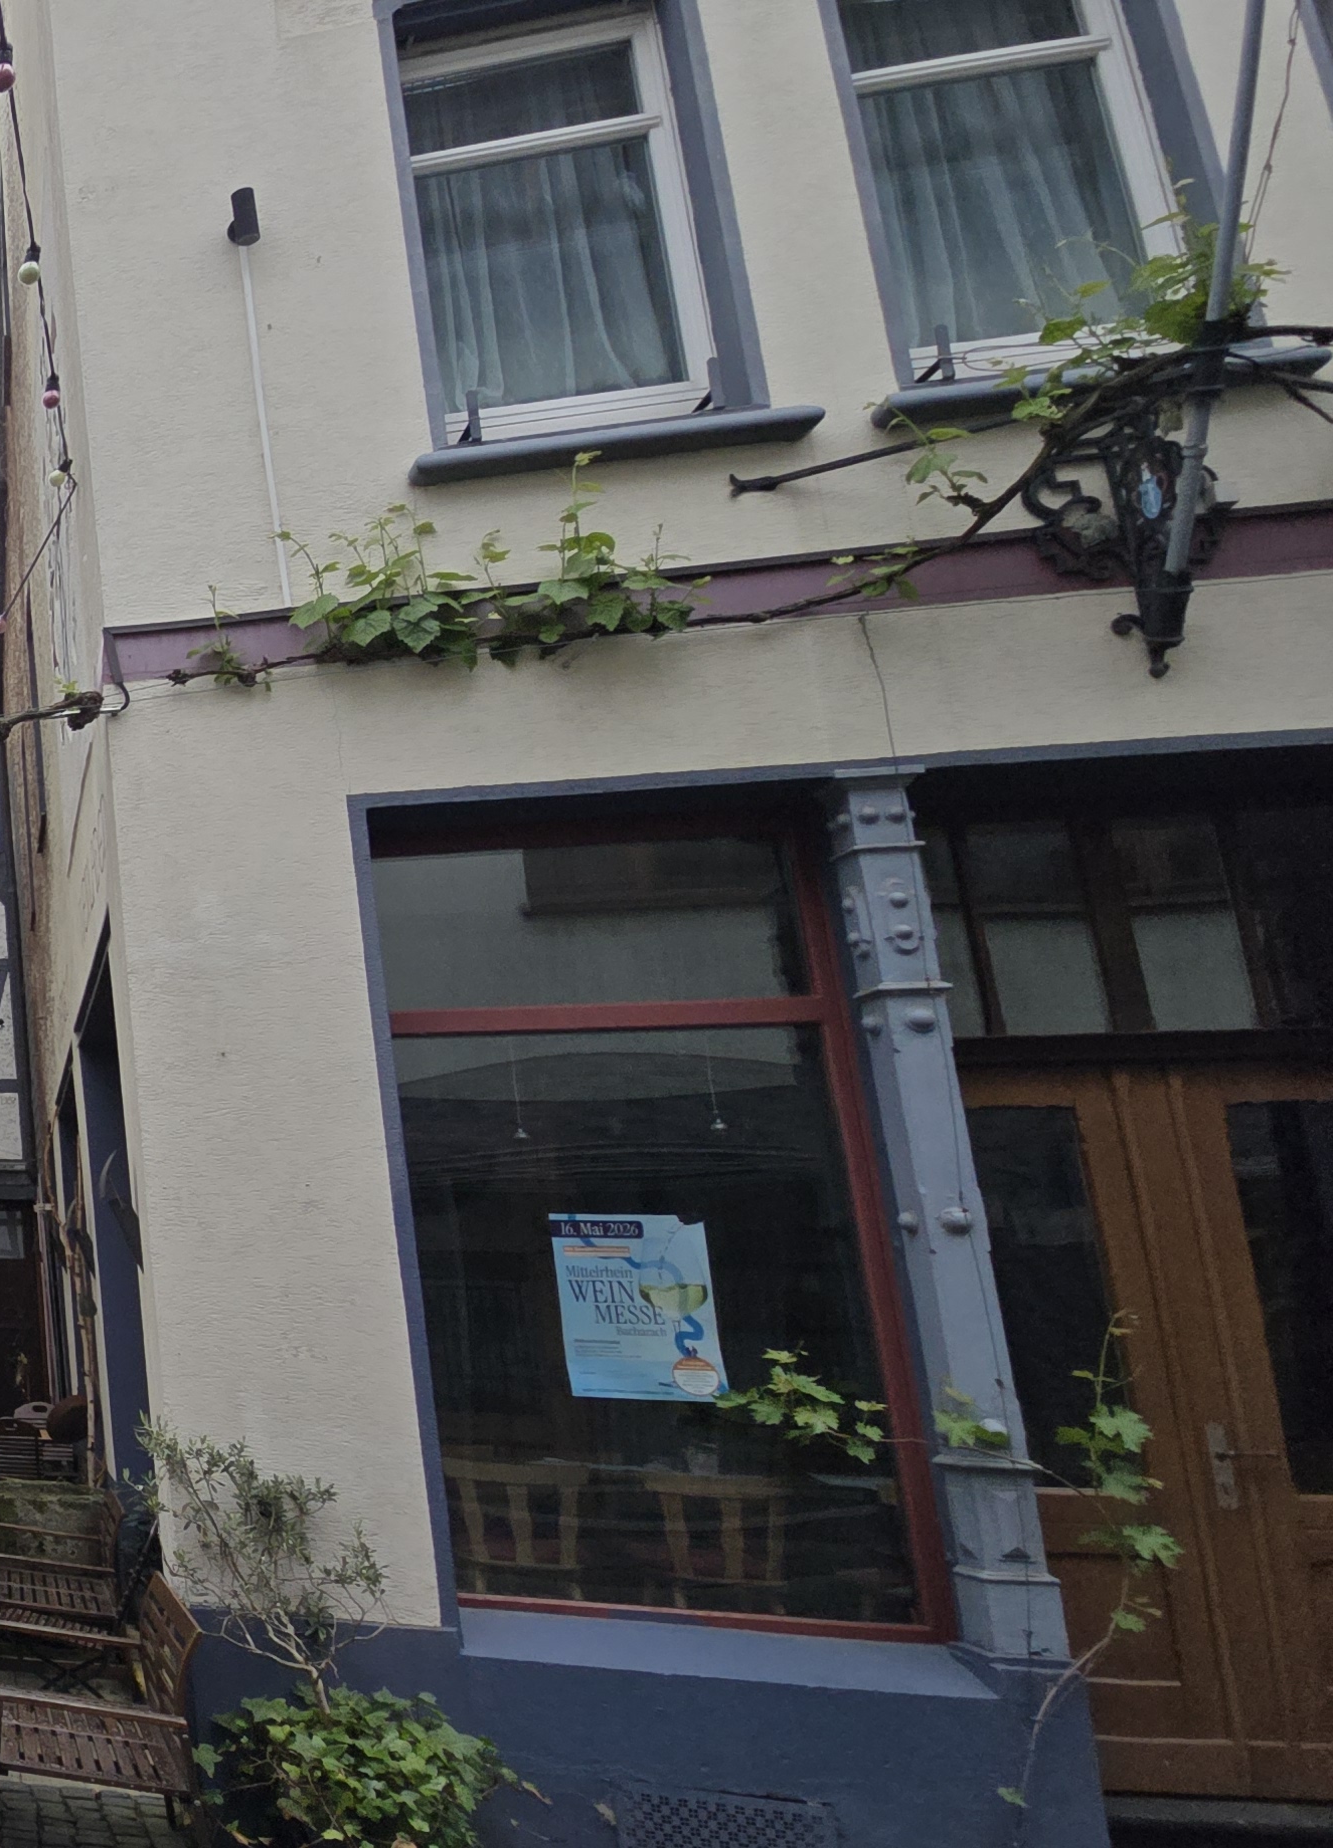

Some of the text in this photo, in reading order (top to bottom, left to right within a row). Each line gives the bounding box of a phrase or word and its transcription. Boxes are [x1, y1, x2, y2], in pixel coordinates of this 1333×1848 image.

[561, 1222, 638, 1235] 16. Mai 2026
[565, 1265, 633, 1278] Mittelrhein
[568, 1279, 635, 1303] WEIN
[594, 1305, 665, 1325] MESSE
